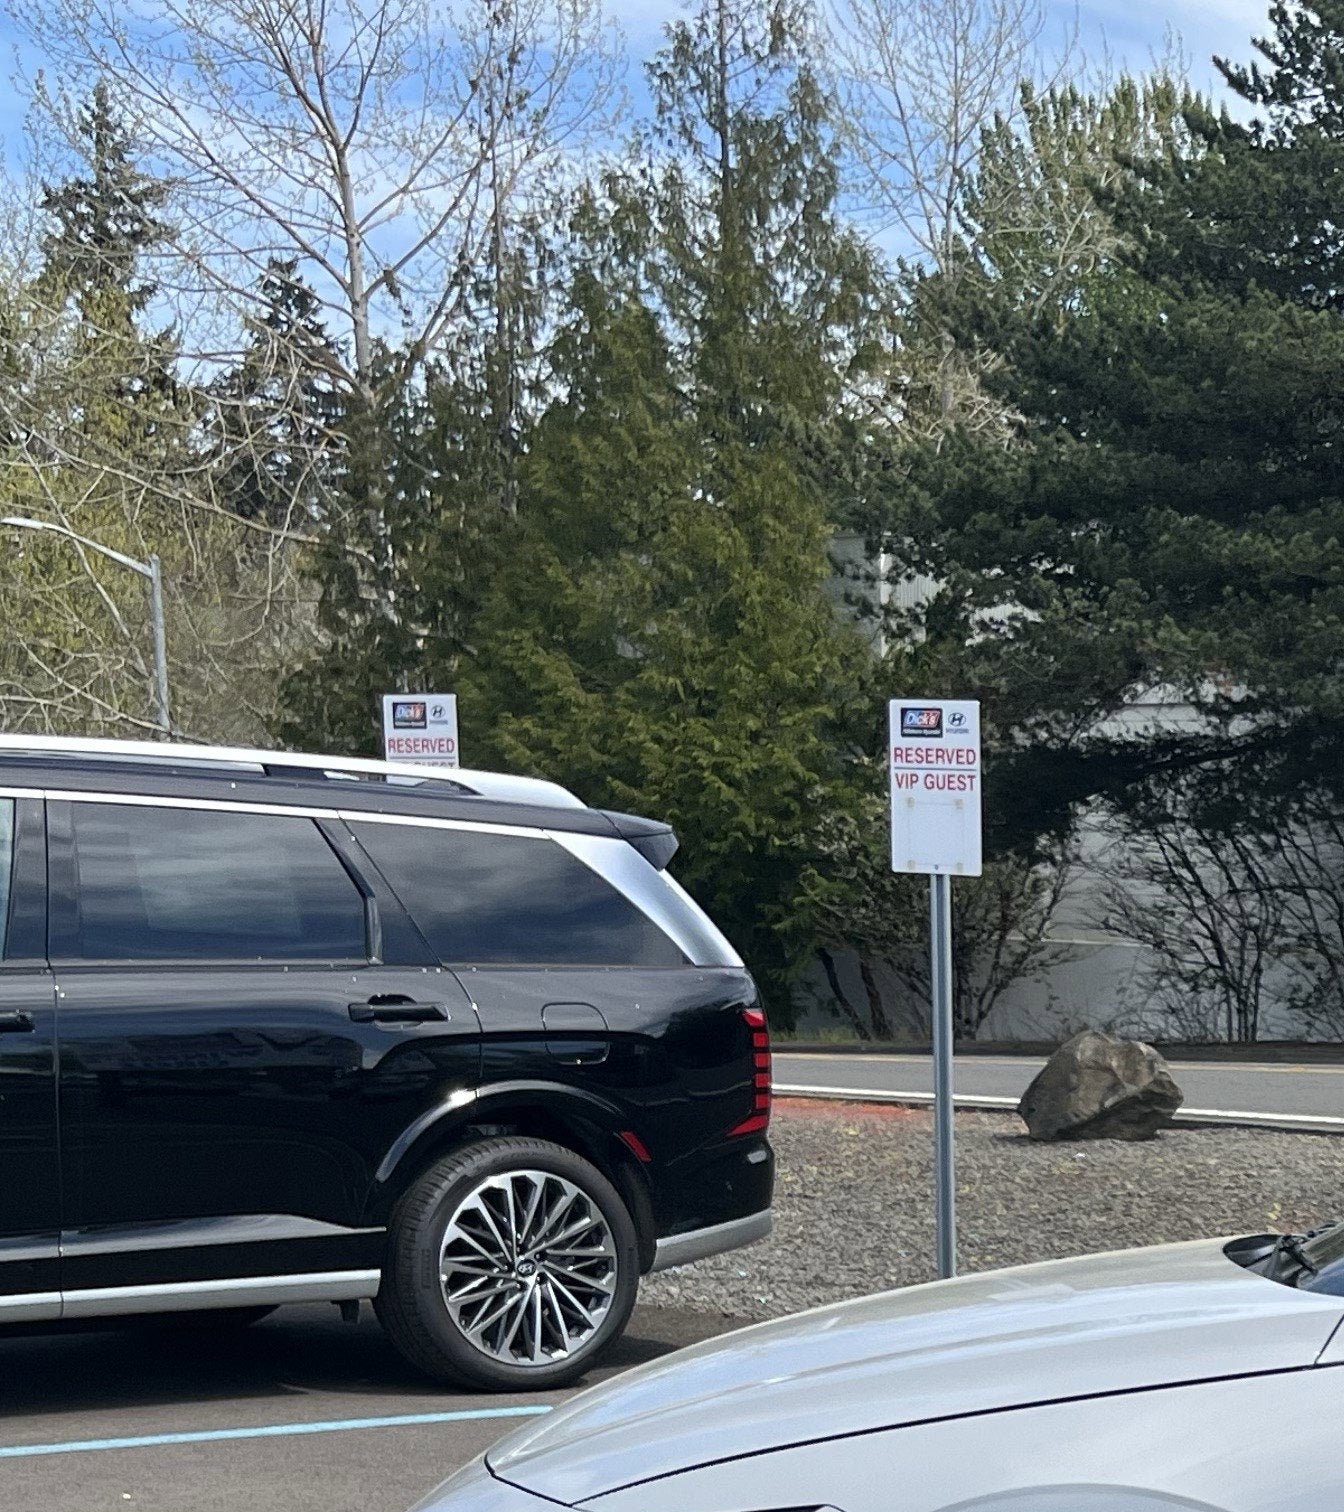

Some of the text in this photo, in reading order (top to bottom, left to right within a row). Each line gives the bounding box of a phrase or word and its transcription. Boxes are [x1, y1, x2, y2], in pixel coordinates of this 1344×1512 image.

[387, 738, 455, 753] RESERVED
[894, 747, 976, 765] RESERVED
[895, 773, 976, 791] VIP GUEST
